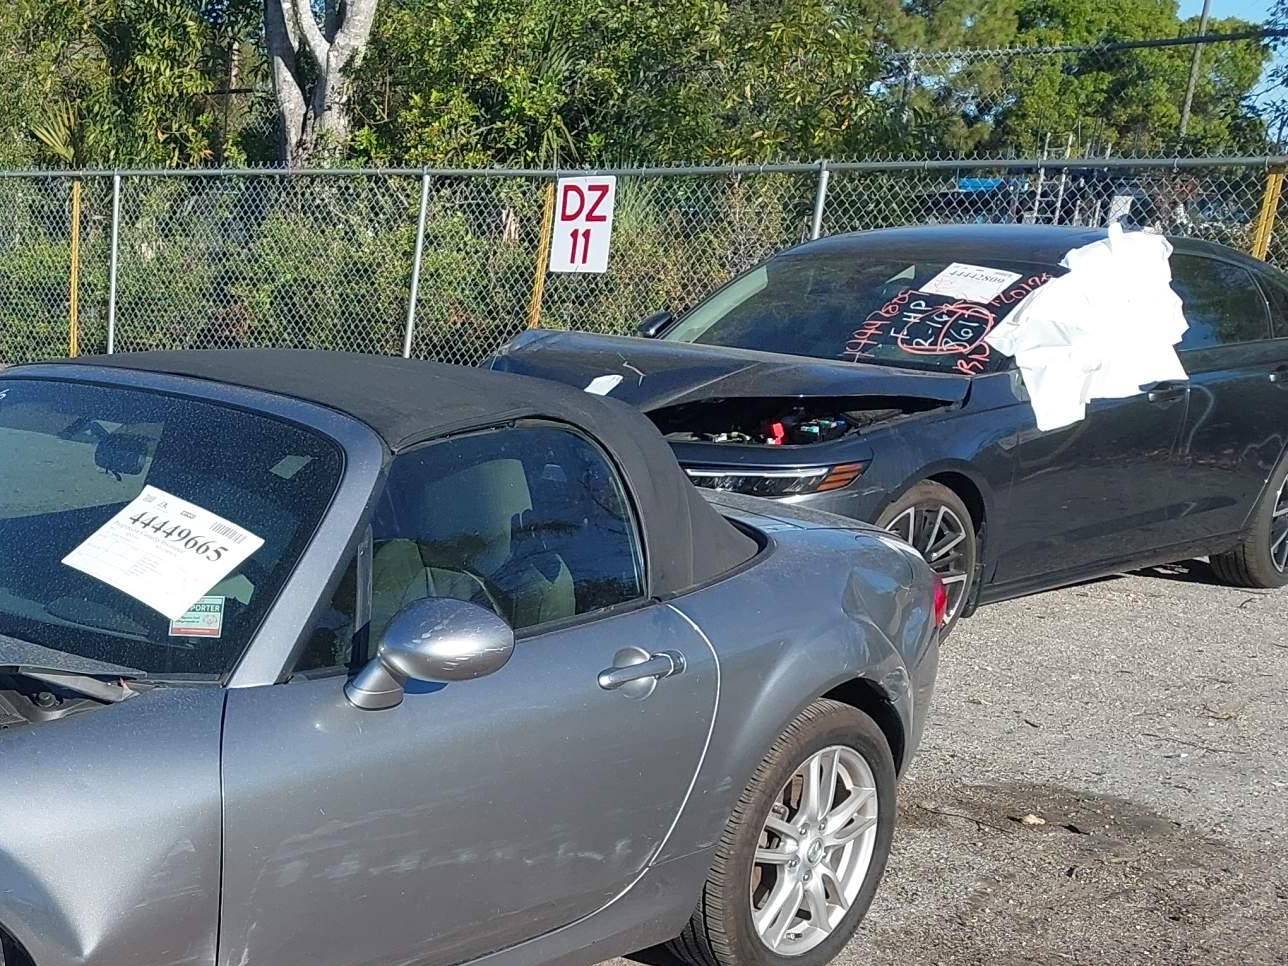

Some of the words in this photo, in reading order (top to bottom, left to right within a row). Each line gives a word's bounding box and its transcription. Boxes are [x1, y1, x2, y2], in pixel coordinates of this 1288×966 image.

[560, 184, 610, 222] DZ
[569, 228, 592, 265] 11
[129, 511, 230, 562] 44449665
